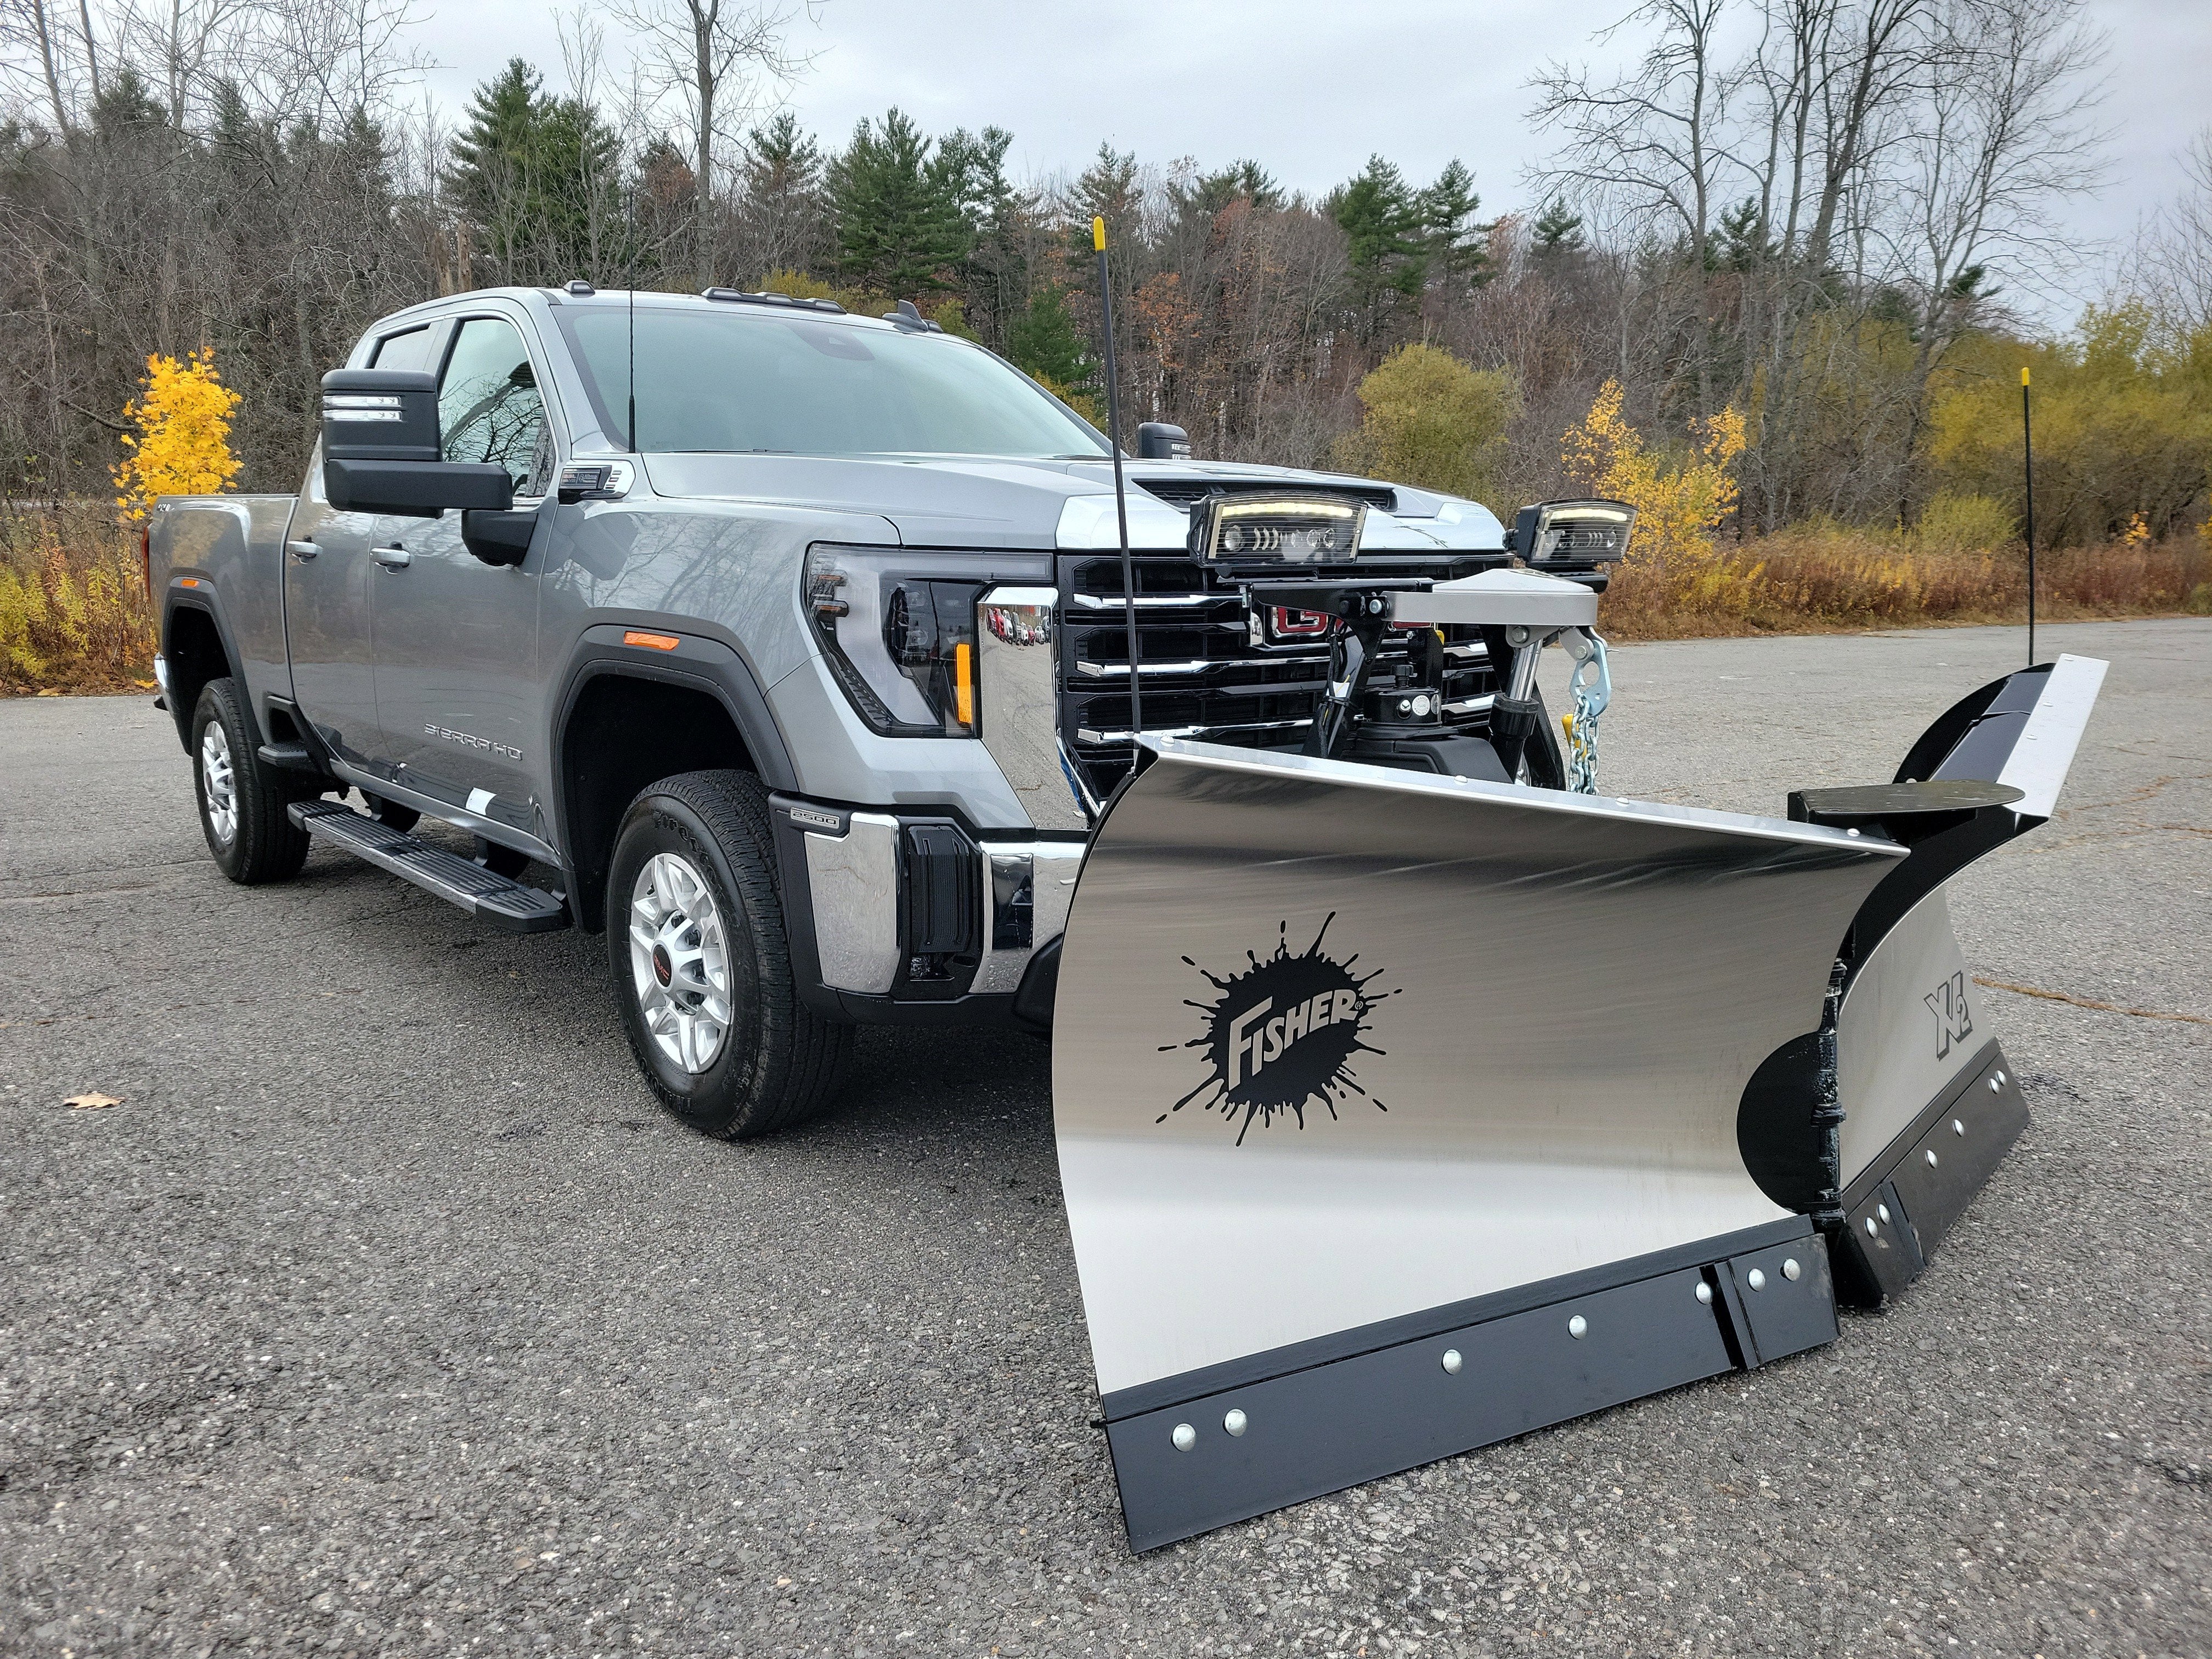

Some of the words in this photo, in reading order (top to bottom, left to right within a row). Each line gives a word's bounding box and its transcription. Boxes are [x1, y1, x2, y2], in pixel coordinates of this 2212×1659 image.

[424, 723, 492, 751] SIERRA
[493, 742, 523, 761] HD
[793, 812, 837, 825] 2500
[1229, 989, 1359, 1092] FISHER
[1923, 969, 1973, 1062] XV2
